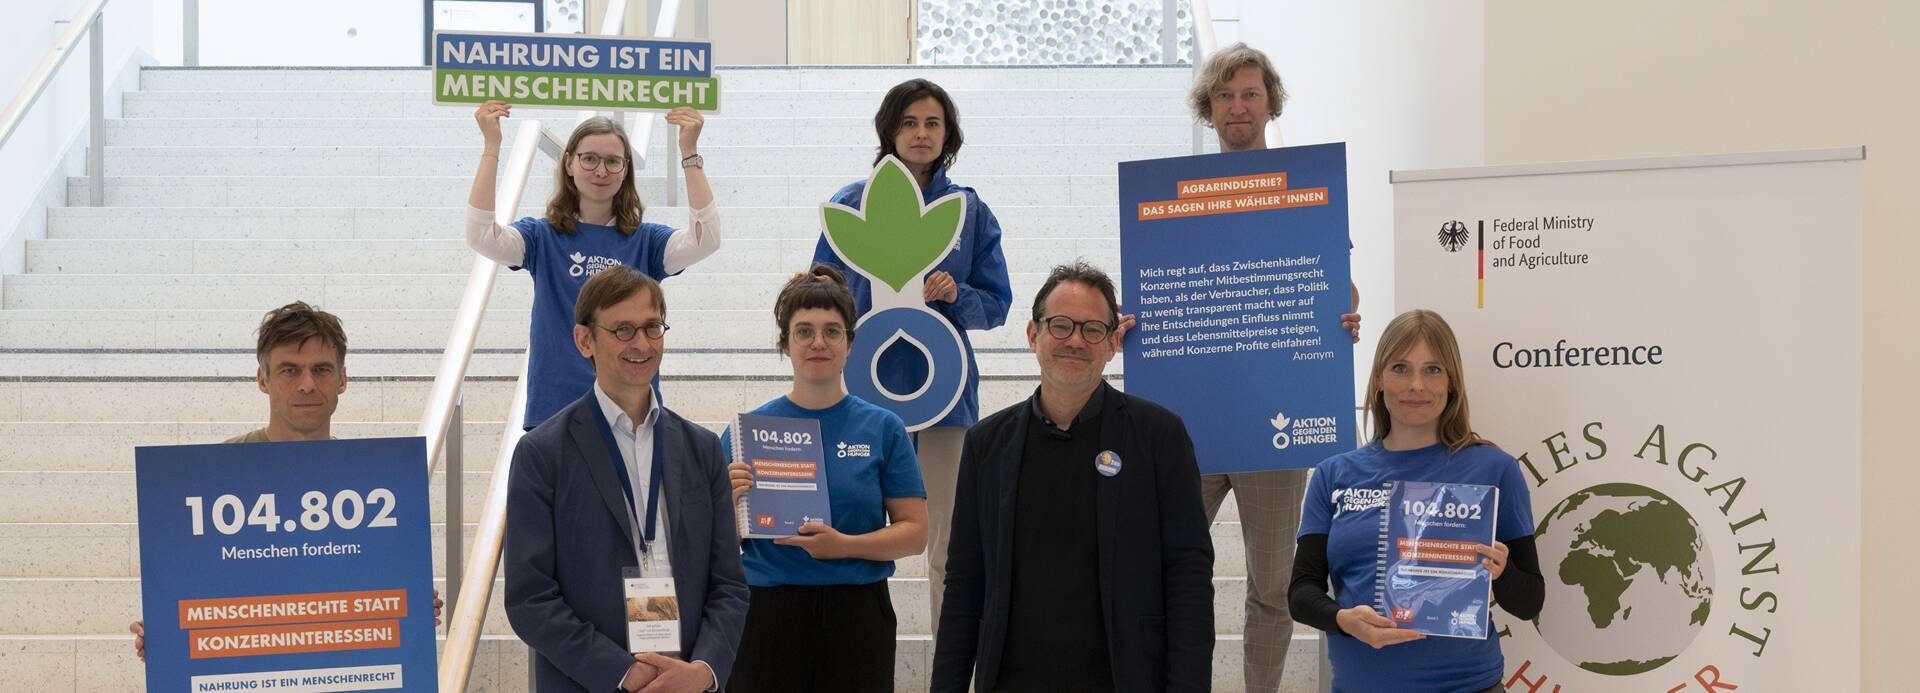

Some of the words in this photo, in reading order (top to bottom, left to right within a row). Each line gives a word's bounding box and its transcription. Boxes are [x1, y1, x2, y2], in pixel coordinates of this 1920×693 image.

[442, 41, 600, 69] NAHRUNG
[610, 46, 650, 70] IST
[658, 48, 706, 72] EIN
[442, 73, 711, 105] MENSCHENRECHT
[1181, 177, 1282, 195] AGRARINDUSTRIE?
[1142, 206, 1165, 216] DAS
[1167, 202, 1205, 214] SAGEN
[1207, 199, 1232, 211] IHRE
[1493, 217, 1539, 232] Federal
[1543, 215, 1595, 232] Ministry
[1493, 236, 1506, 250] of
[1509, 234, 1541, 249] Food
[587, 255, 622, 266] AKTION
[1140, 267, 1165, 279] Mich
[1166, 266, 1187, 278] regt
[1188, 264, 1207, 275] auf,
[1209, 262, 1231, 273] dass
[1232, 255, 1321, 271] Zwischenhändler/
[1492, 253, 1515, 268] and
[1518, 251, 1589, 270] Agriculture
[1140, 280, 1187, 292] Konzerne
[1188, 278, 1214, 288] mehr
[1216, 269, 1324, 286] Mitbestimmungsrecht
[1140, 294, 1173, 305] haben,
[1175, 292, 1189, 302] als
[1190, 290, 1208, 301] der
[1208, 285, 1271, 300] Verbraucher,
[1273, 284, 1295, 294] dass
[1297, 281, 1329, 293] Politik
[1140, 310, 1153, 318] zu
[1154, 307, 1184, 319] wenig
[1185, 303, 1242, 316] transparent
[1244, 300, 1275, 311] macht
[1277, 299, 1296, 308] wer
[1298, 296, 1315, 306] auf
[1141, 320, 1160, 332] ihre
[1162, 316, 1240, 330] Entscheidungen
[1241, 313, 1280, 324] Einfluss
[1282, 310, 1314, 321] nimmt
[1141, 335, 1161, 345] und
[1162, 332, 1184, 343] dass
[1186, 324, 1279, 341] Lebensmittelpreise
[1280, 325, 1319, 337] steigen,
[1141, 347, 1185, 359] während
[1186, 344, 1233, 355] Konzerne
[1235, 340, 1270, 352] Profite
[1271, 336, 1321, 350] einfahren!
[1292, 350, 1335, 361] Anonym
[1492, 339, 1663, 369] Conference
[1292, 416, 1336, 428] AKTION
[1292, 428, 1319, 436] GEGEN
[751, 428, 813, 445] 104.802
[1292, 434, 1337, 445] HUNGER
[185, 488, 398, 536] 104.802
[1403, 501, 1482, 520] 104.802
[222, 544, 298, 560] Menschen
[302, 541, 361, 557] fordern:
[1633, 424, 1780, 658] AGAINST
[187, 599, 348, 622] MENSCHENRECHTE
[353, 596, 400, 614] STATT
[197, 627, 393, 652] KONZERNINTERESSEN!
[199, 680, 258, 692] NAHRUNG
[261, 679, 277, 688] IST
[280, 678, 298, 687] EIN
[302, 672, 396, 686] MENSCHENRECHT
